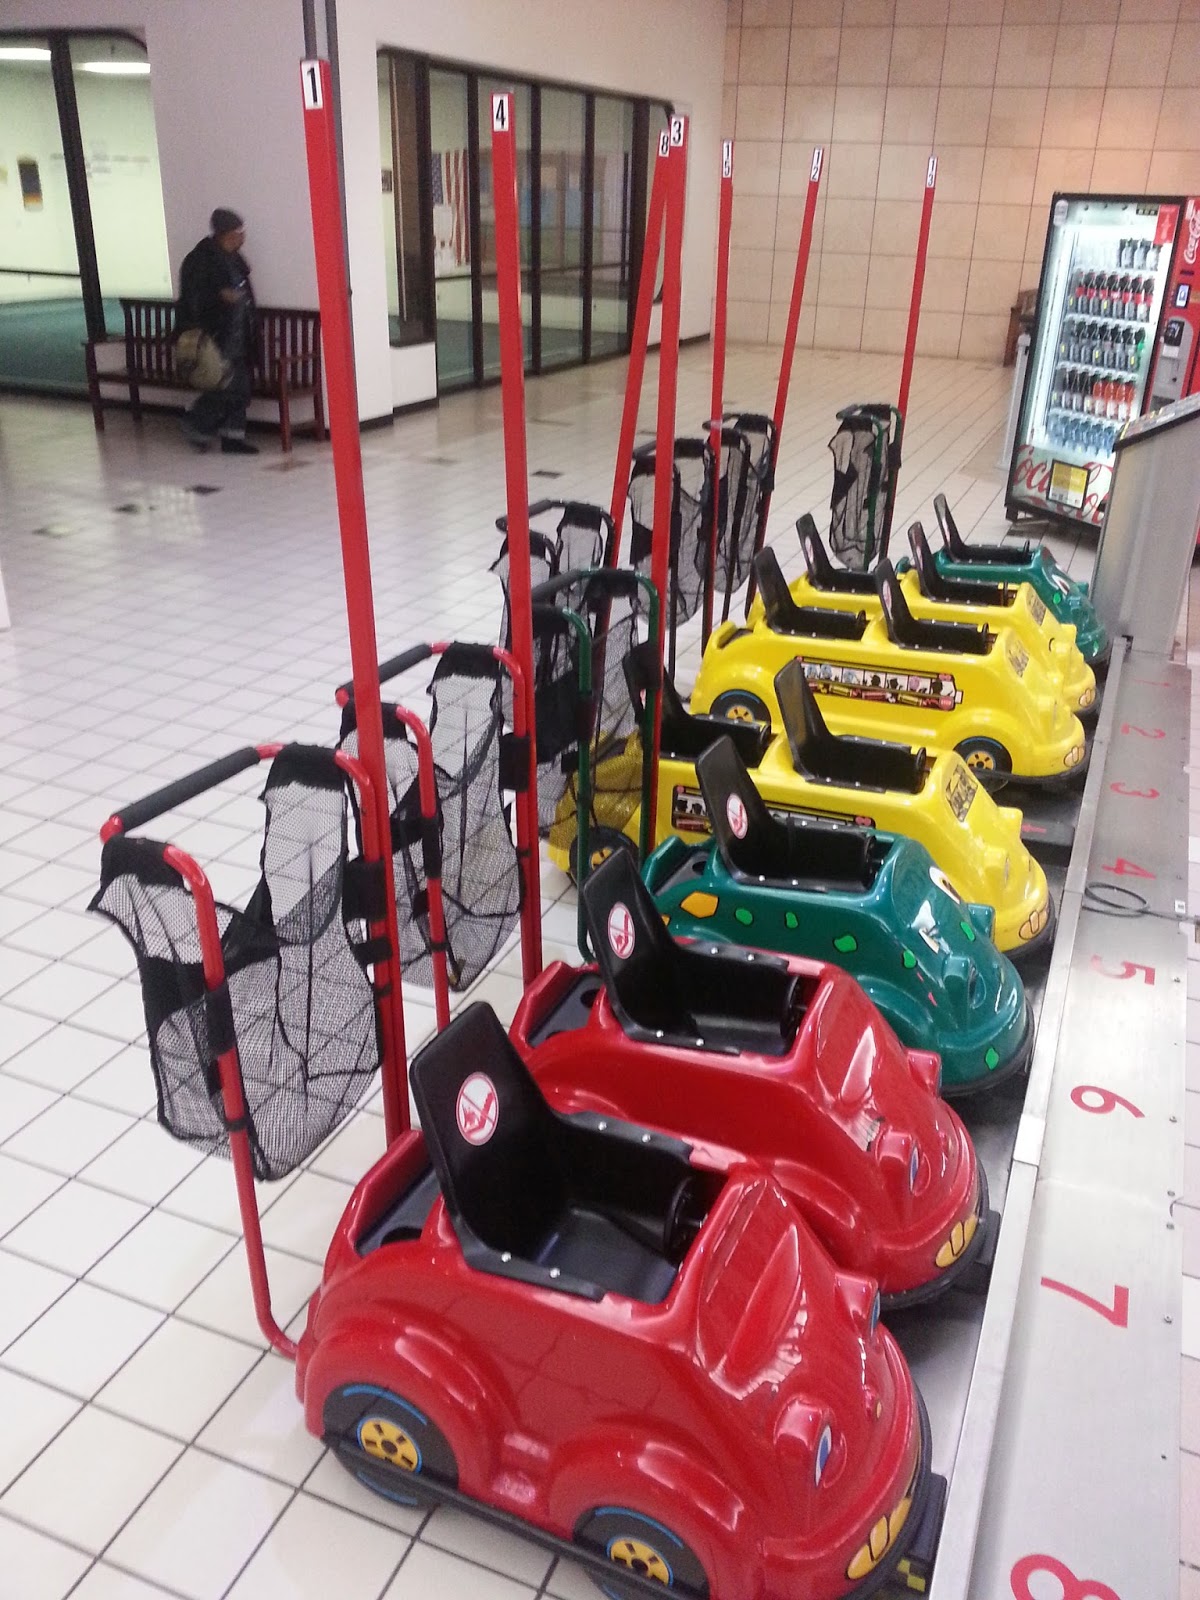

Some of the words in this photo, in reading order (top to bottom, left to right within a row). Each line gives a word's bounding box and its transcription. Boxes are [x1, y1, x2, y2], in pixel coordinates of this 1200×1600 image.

[306, 67, 319, 106] 1
[495, 99, 505, 129] 4
[661, 134, 669, 155] 8
[672, 120, 682, 145] 3
[811, 151, 820, 180] 12
[1121, 722, 1167, 741] 2
[1109, 781, 1161, 801] 3
[1102, 856, 1157, 881] 4
[1090, 954, 1156, 986] 5
[1070, 1085, 1144, 1119] 6
[1040, 1276, 1130, 1329] 7
